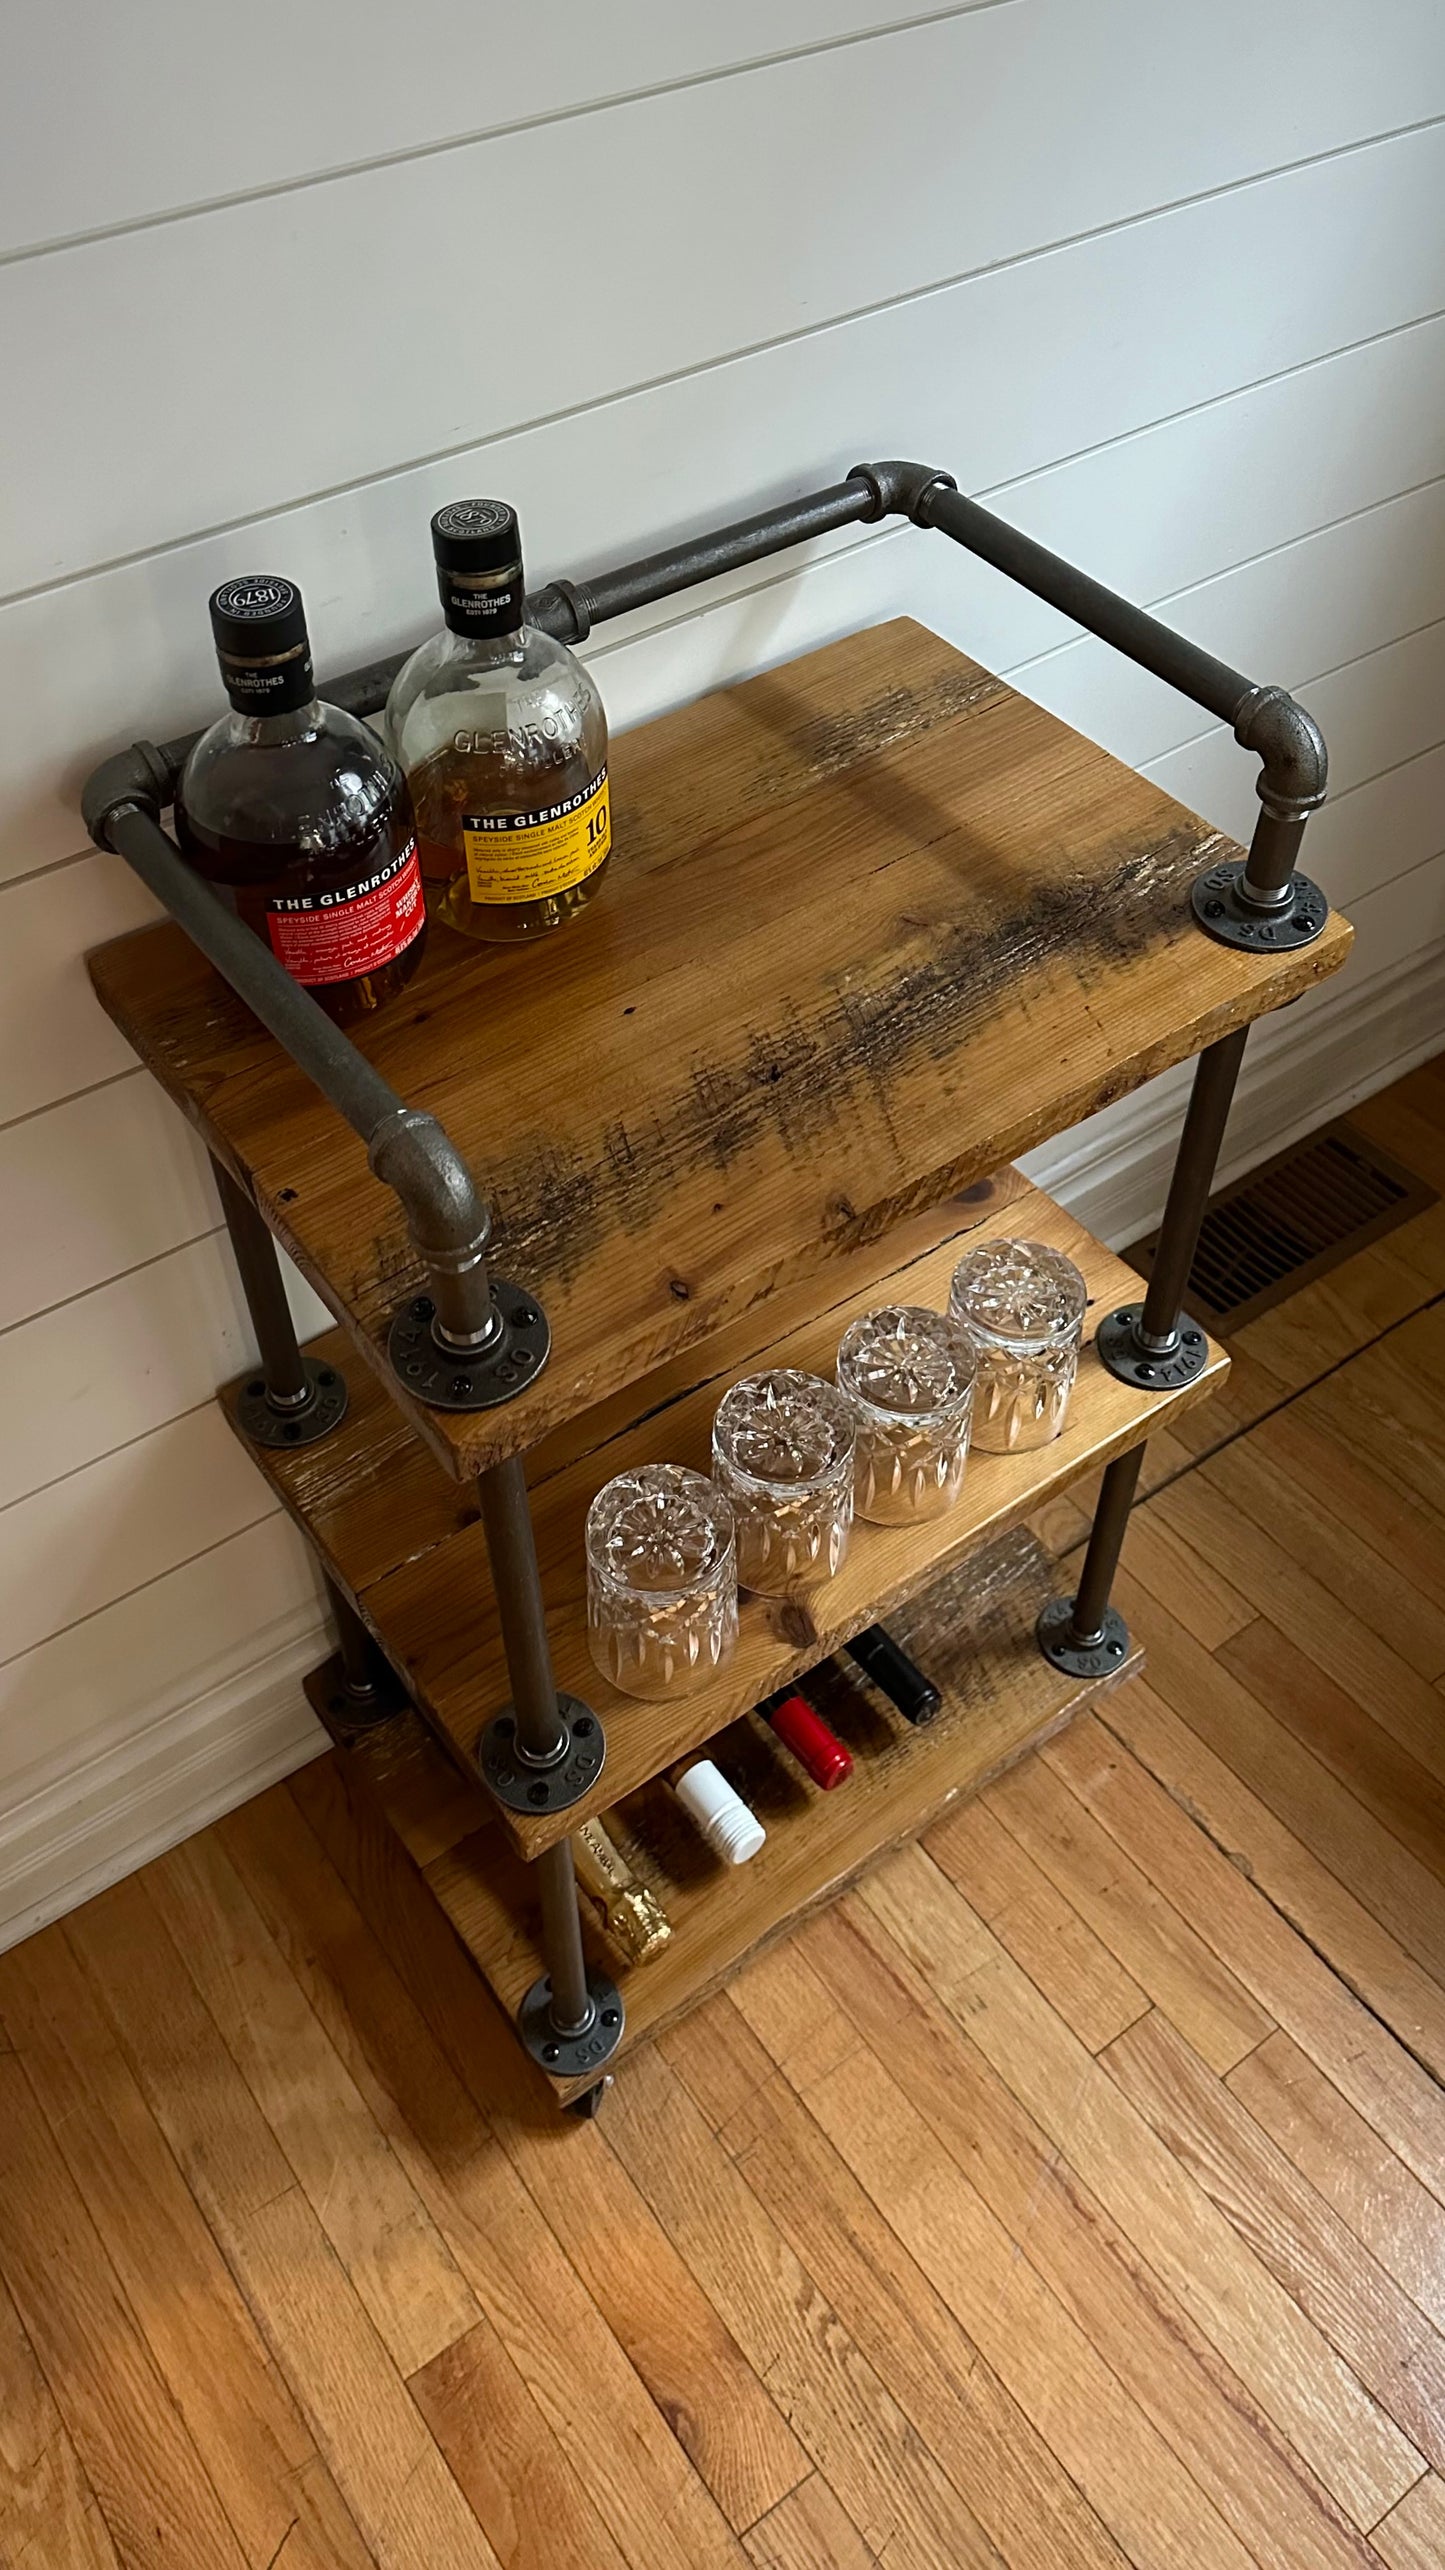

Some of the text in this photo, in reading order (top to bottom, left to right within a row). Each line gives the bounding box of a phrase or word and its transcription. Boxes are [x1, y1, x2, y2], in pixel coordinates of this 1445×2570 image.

[233, 588, 277, 607] 1879
[451, 594, 511, 609] GLENROTHES
[453, 680, 592, 755] GLENROTHES
[470, 767, 606, 830] THE GLENROTHES
[473, 835, 513, 843] SPEYSIDE
[515, 830, 545, 841] SINGLE
[547, 820, 567, 833] MALT
[569, 803, 592, 823] SCOTCH
[585, 805, 607, 847] 10
[272, 837, 415, 911] THE GLENROTHES
[276, 915, 320, 924] SPEYSIDE
[322, 907, 354, 920] SINGLE
[356, 895, 377, 910] MALT
[378, 876, 403, 898] SCOTCH
[404, 898, 417, 918] CUT
